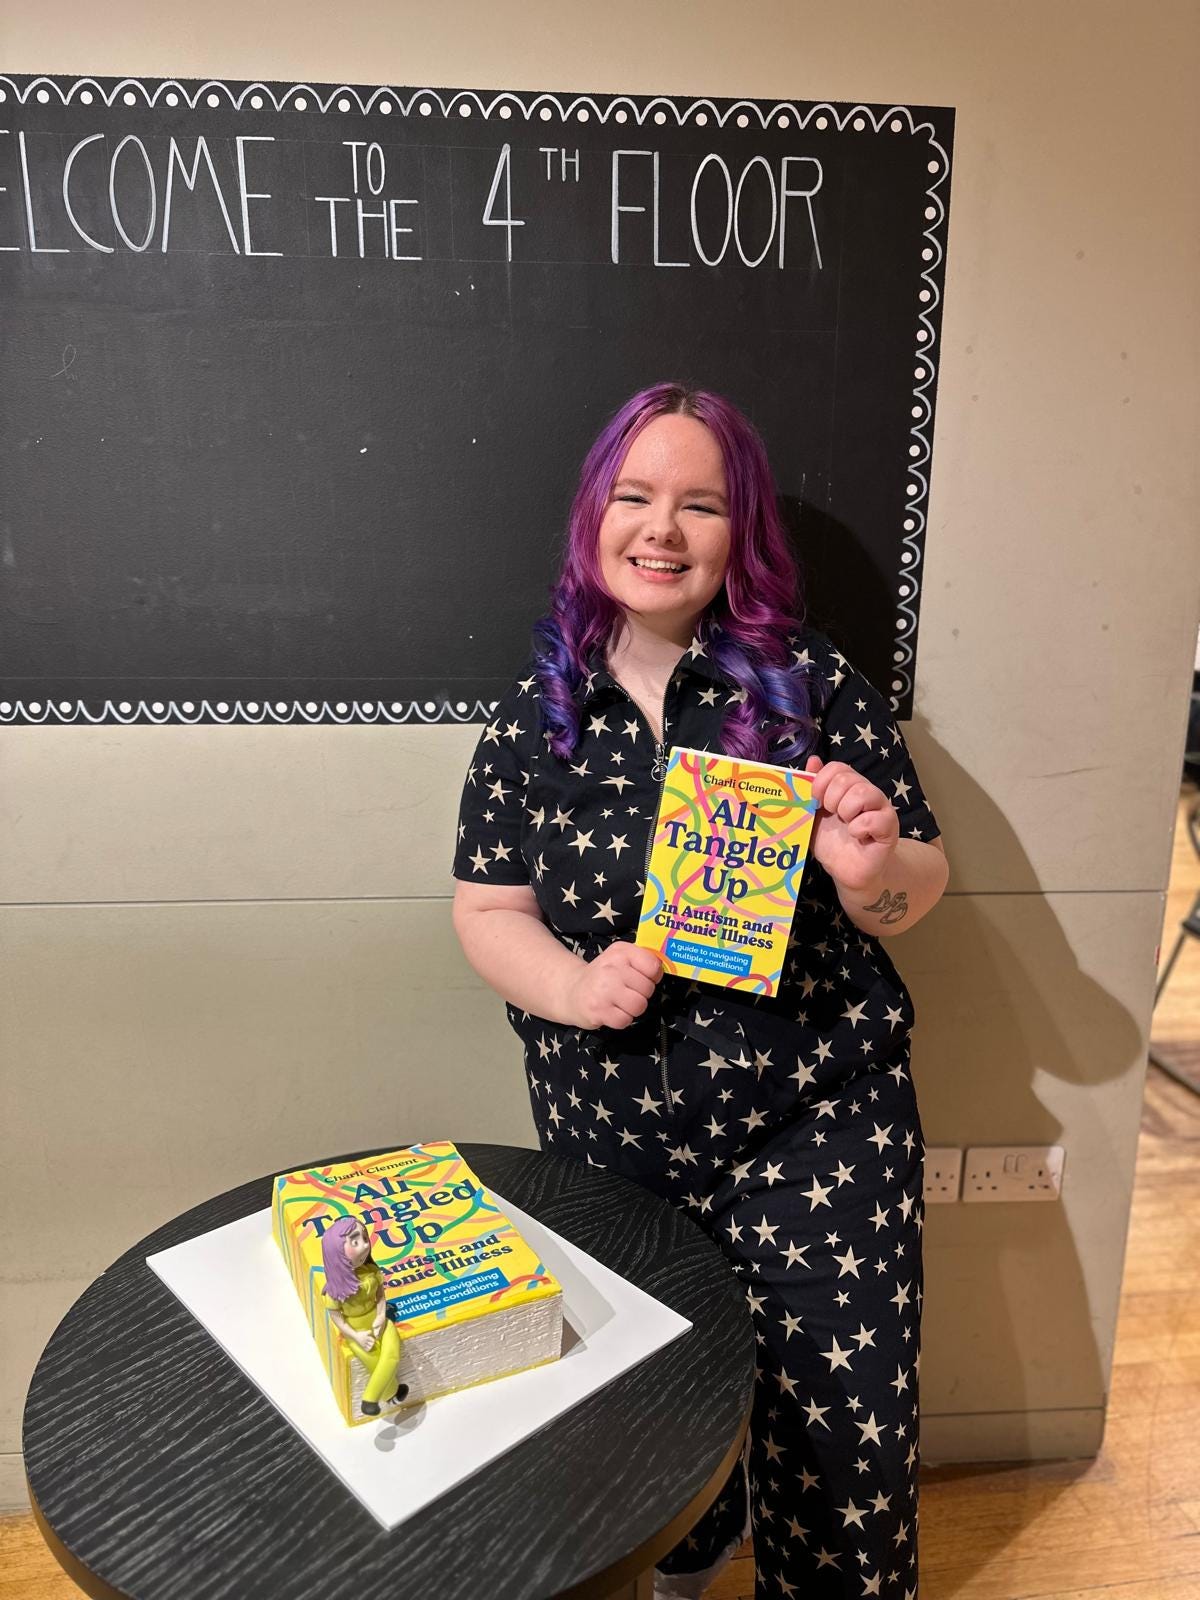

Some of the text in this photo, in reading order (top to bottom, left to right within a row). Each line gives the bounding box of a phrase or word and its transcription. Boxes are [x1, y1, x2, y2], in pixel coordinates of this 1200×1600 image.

[342, 140, 387, 196] TO
[610, 149, 824, 270] FLOOR
[314, 196, 424, 261] THE
[703, 774, 783, 798] Charli Clement
[708, 798, 760, 832] All
[664, 819, 801, 871] Tangled
[702, 865, 749, 905] Up
[654, 913, 774, 950] Chronic Illness
[661, 900, 774, 935] in Autism and
[672, 951, 744, 972] multiple conditions
[677, 943, 699, 954] guide
[708, 951, 749, 967] navigating
[324, 1157, 418, 1185] Charli Clement
[302, 1178, 478, 1239] Tngled
[375, 1221, 444, 1249] Up
[459, 1233, 501, 1254] and
[384, 1245, 513, 1288] onic Illness
[394, 1297, 442, 1318] multiple
[443, 1281, 500, 1303] conditions
[395, 1293, 428, 1310] guide
[428, 1288, 442, 1298] to
[442, 1271, 500, 1294] navigating
